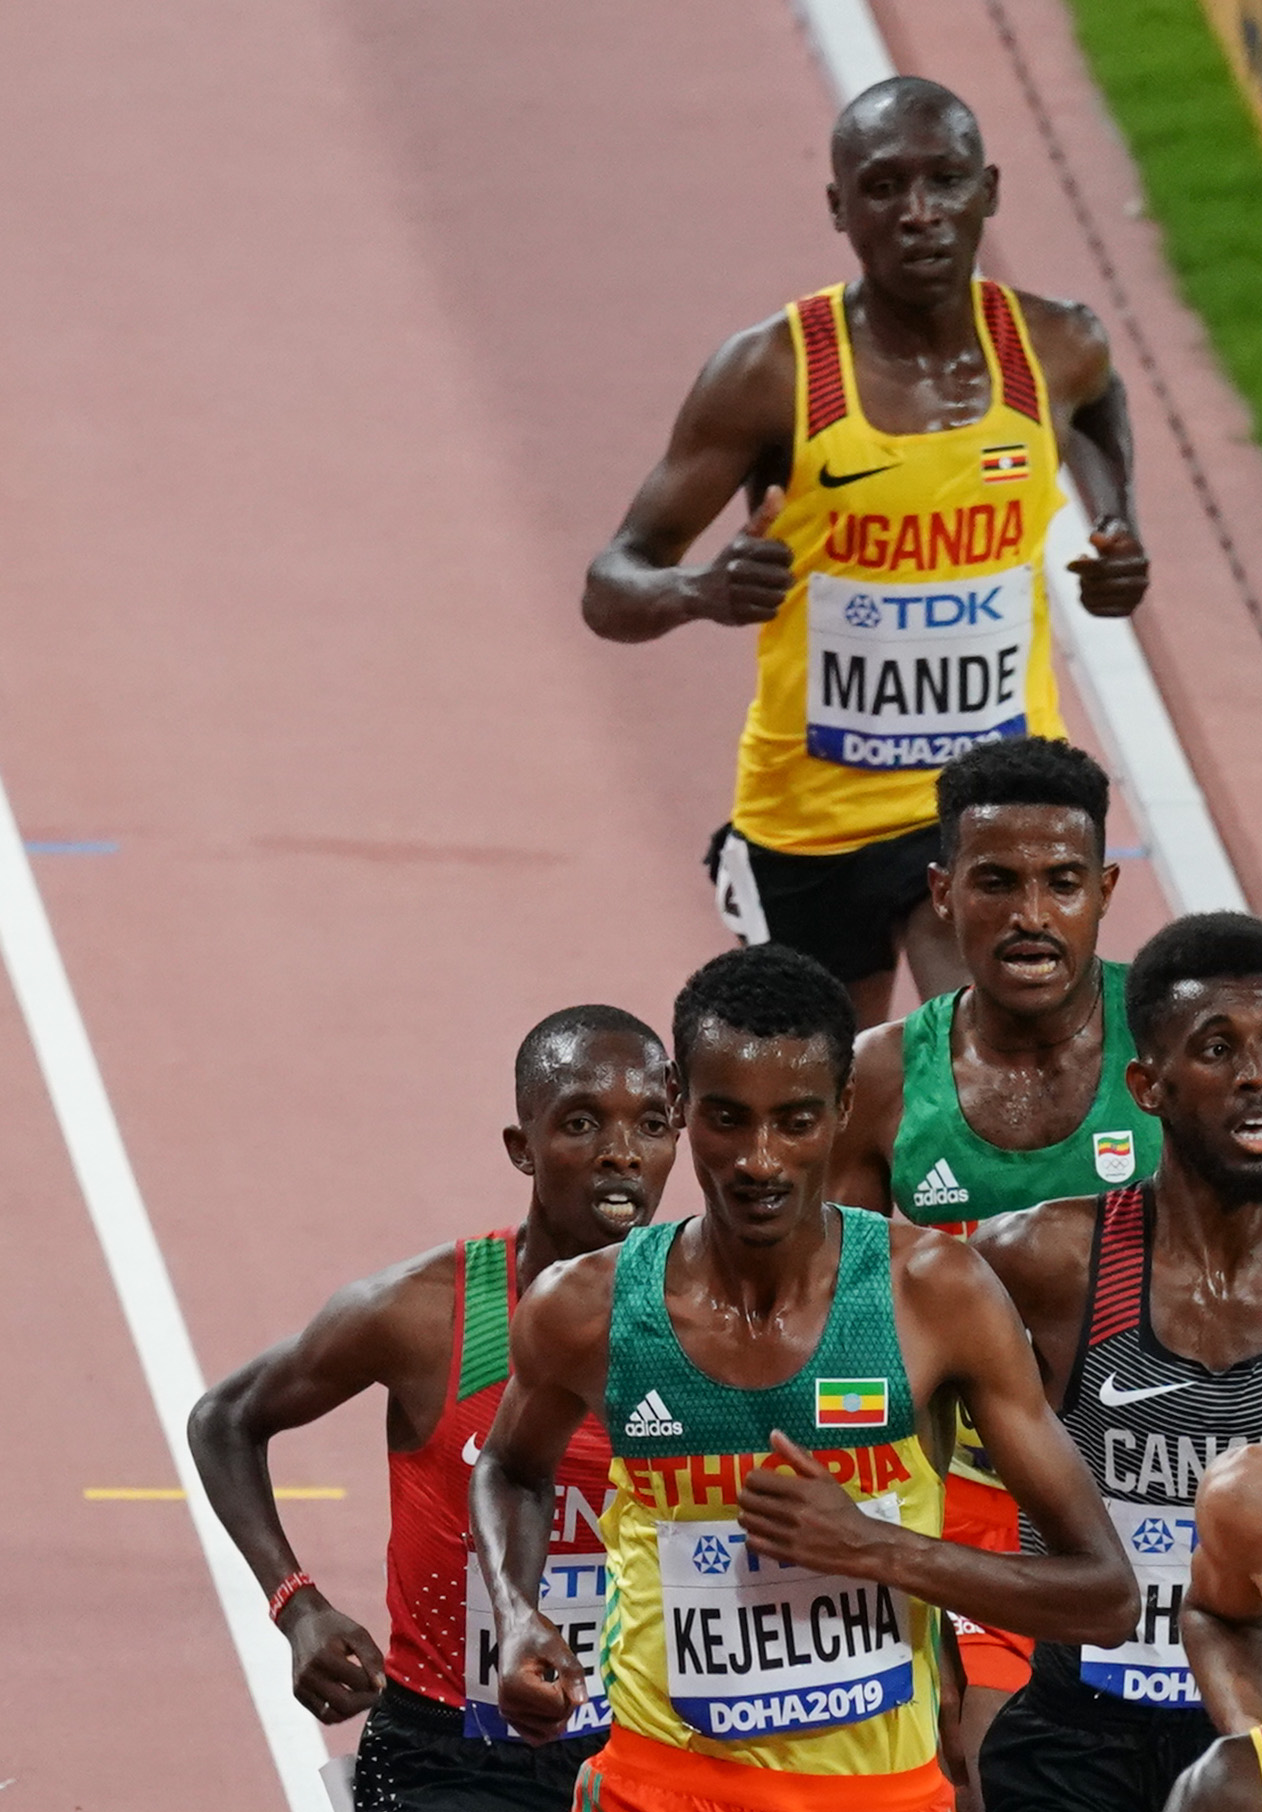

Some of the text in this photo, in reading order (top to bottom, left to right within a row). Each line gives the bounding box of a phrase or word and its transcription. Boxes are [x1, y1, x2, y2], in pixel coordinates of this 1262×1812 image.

[823, 500, 1024, 571] UGANDA
[882, 586, 1004, 630] TDK
[822, 644, 1019, 716] MANDE
[913, 1187, 969, 1207] adidas
[625, 1419, 683, 1437] adidas
[673, 1582, 900, 1675] KEJELCHA
[710, 1680, 883, 1734] DOHA2019
